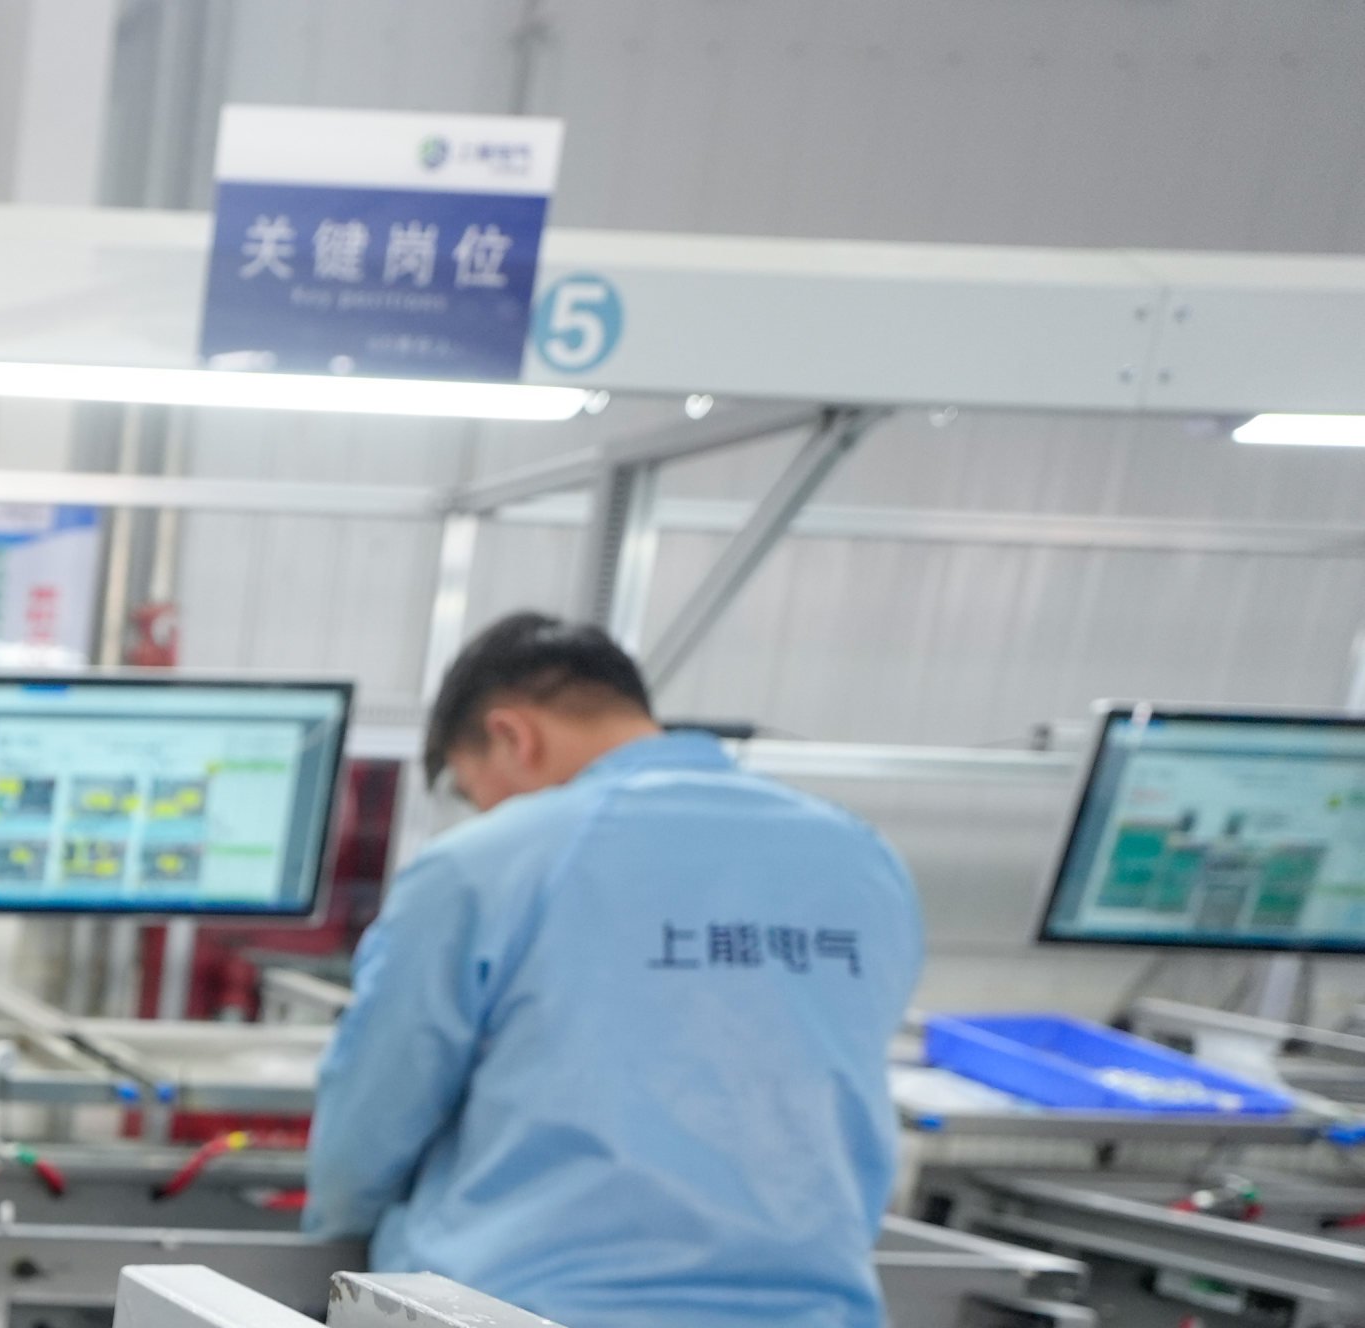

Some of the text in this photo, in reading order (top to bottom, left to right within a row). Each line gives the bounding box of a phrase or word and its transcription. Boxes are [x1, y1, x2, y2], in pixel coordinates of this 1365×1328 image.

[237, 214, 514, 289] 关键岗位
[544, 284, 608, 367] 5
[646, 920, 863, 978] 上能电气
